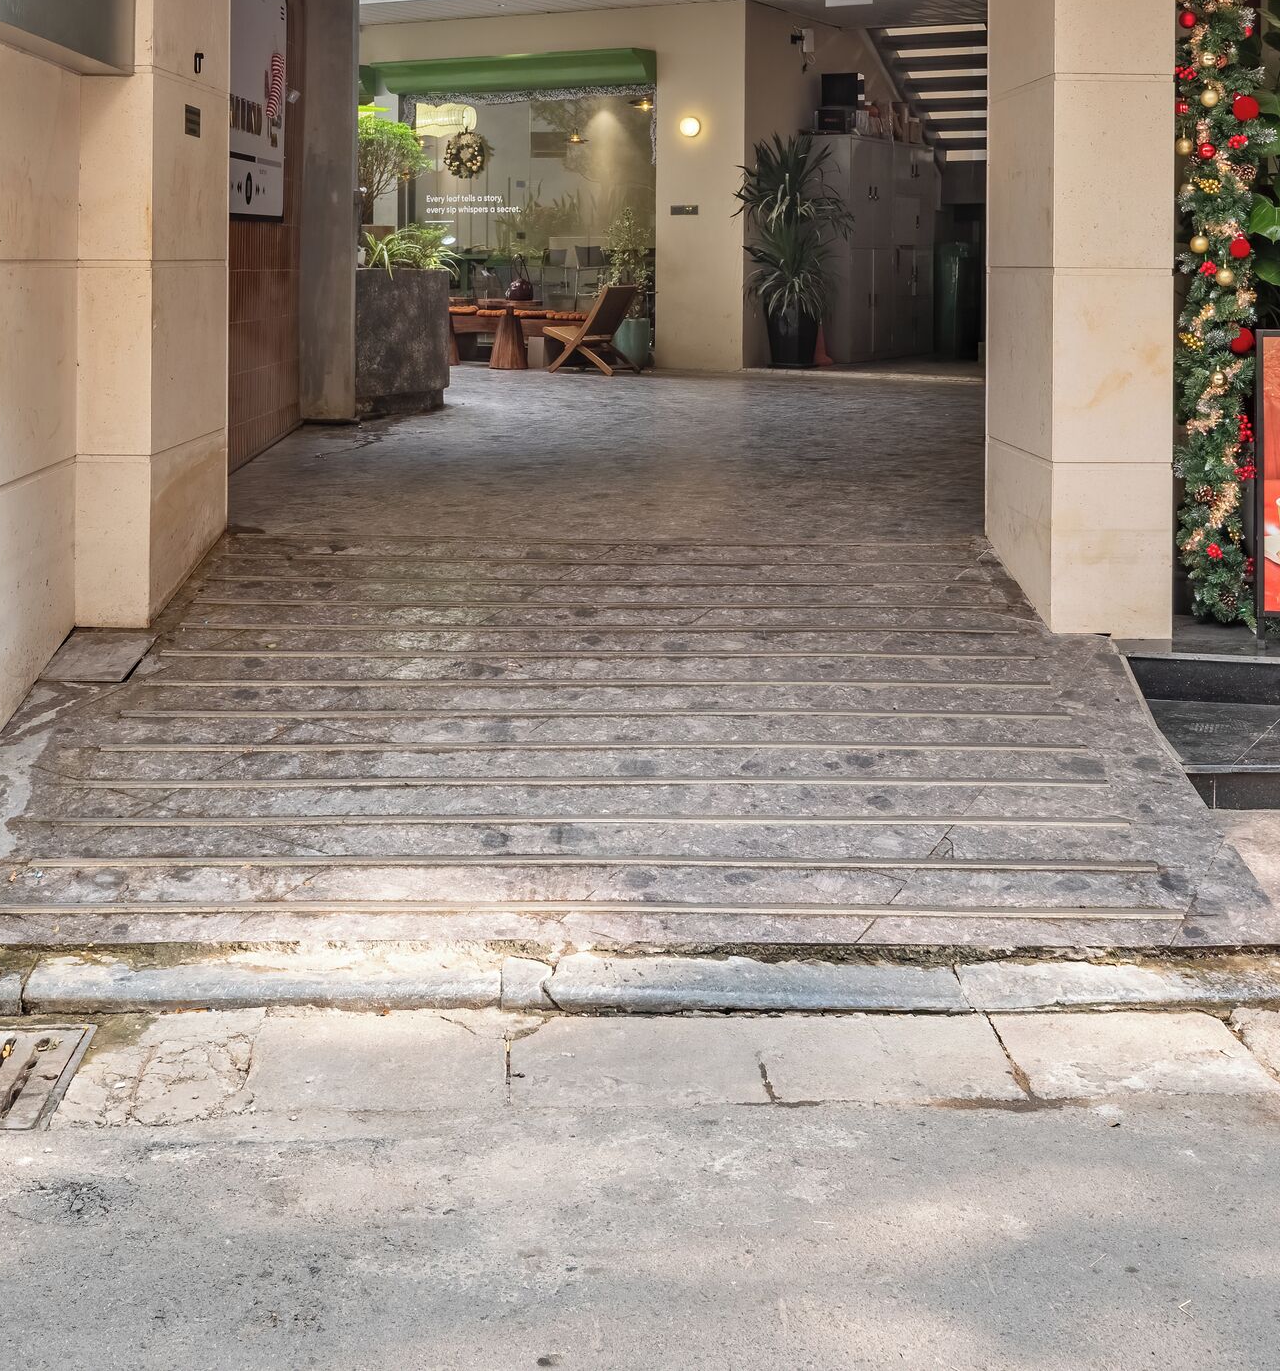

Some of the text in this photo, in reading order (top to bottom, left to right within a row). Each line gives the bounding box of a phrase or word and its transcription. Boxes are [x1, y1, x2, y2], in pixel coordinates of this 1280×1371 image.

[426, 195, 445, 204] Every
[446, 194, 460, 202] leaf
[461, 194, 476, 202] tells
[483, 195, 503, 203] story,
[426, 207, 445, 215] every
[446, 206, 457, 214] sip
[458, 206, 489, 214] whispers
[496, 205, 521, 213] secret.
